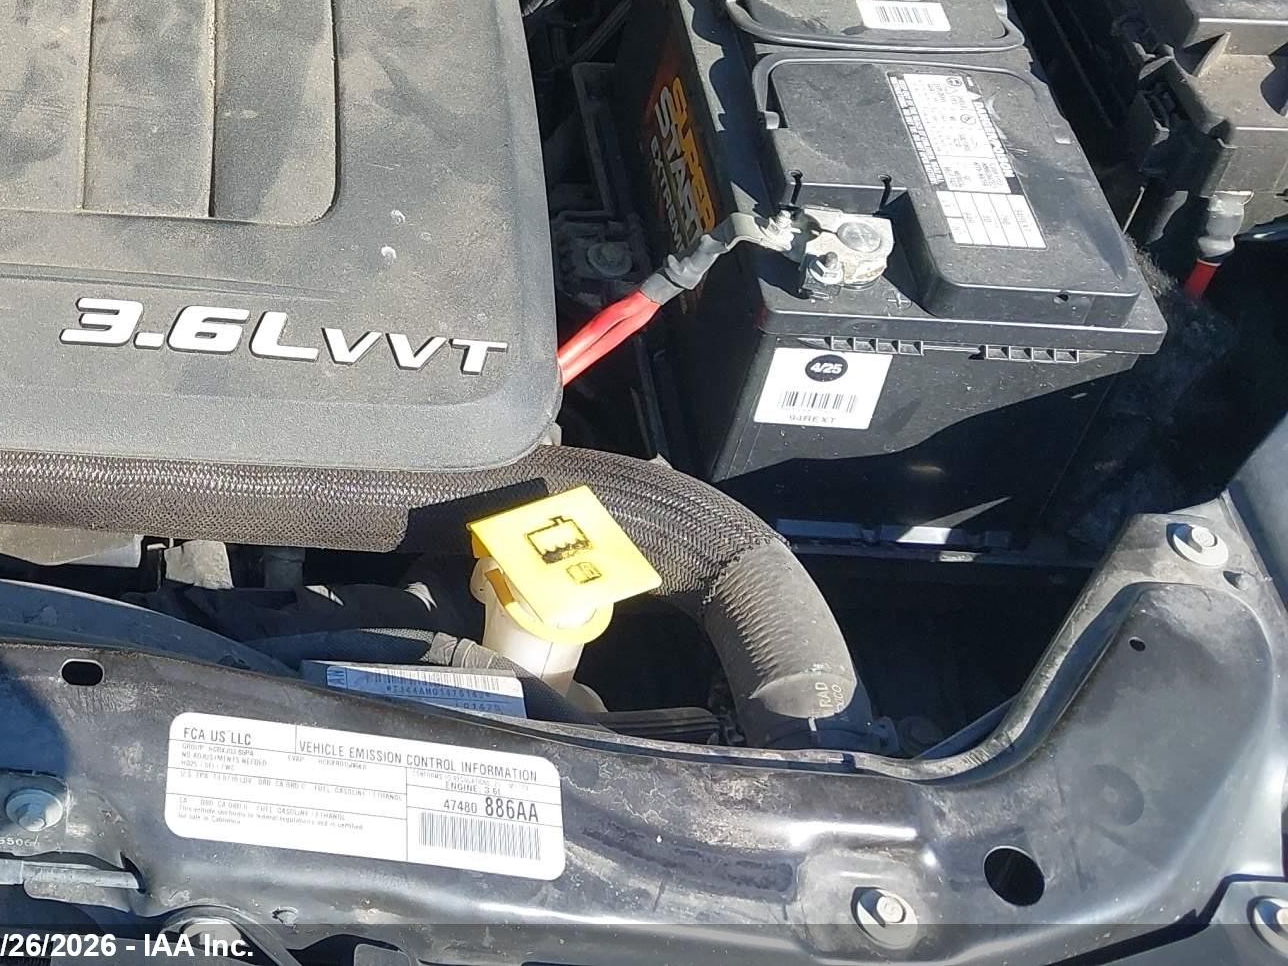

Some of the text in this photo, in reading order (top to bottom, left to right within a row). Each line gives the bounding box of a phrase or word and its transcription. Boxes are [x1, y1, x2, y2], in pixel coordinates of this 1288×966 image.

[59, 297, 509, 376] 3.6L VVT
[810, 362, 844, 374] 4/25
[184, 728, 252, 746] FCA US LLC
[299, 740, 344, 757] VEHICLE
[349, 746, 402, 764] EMISSION
[406, 754, 456, 772] CONTROL
[461, 761, 538, 782] INFORMATION
[485, 796, 539, 822] 886AA
